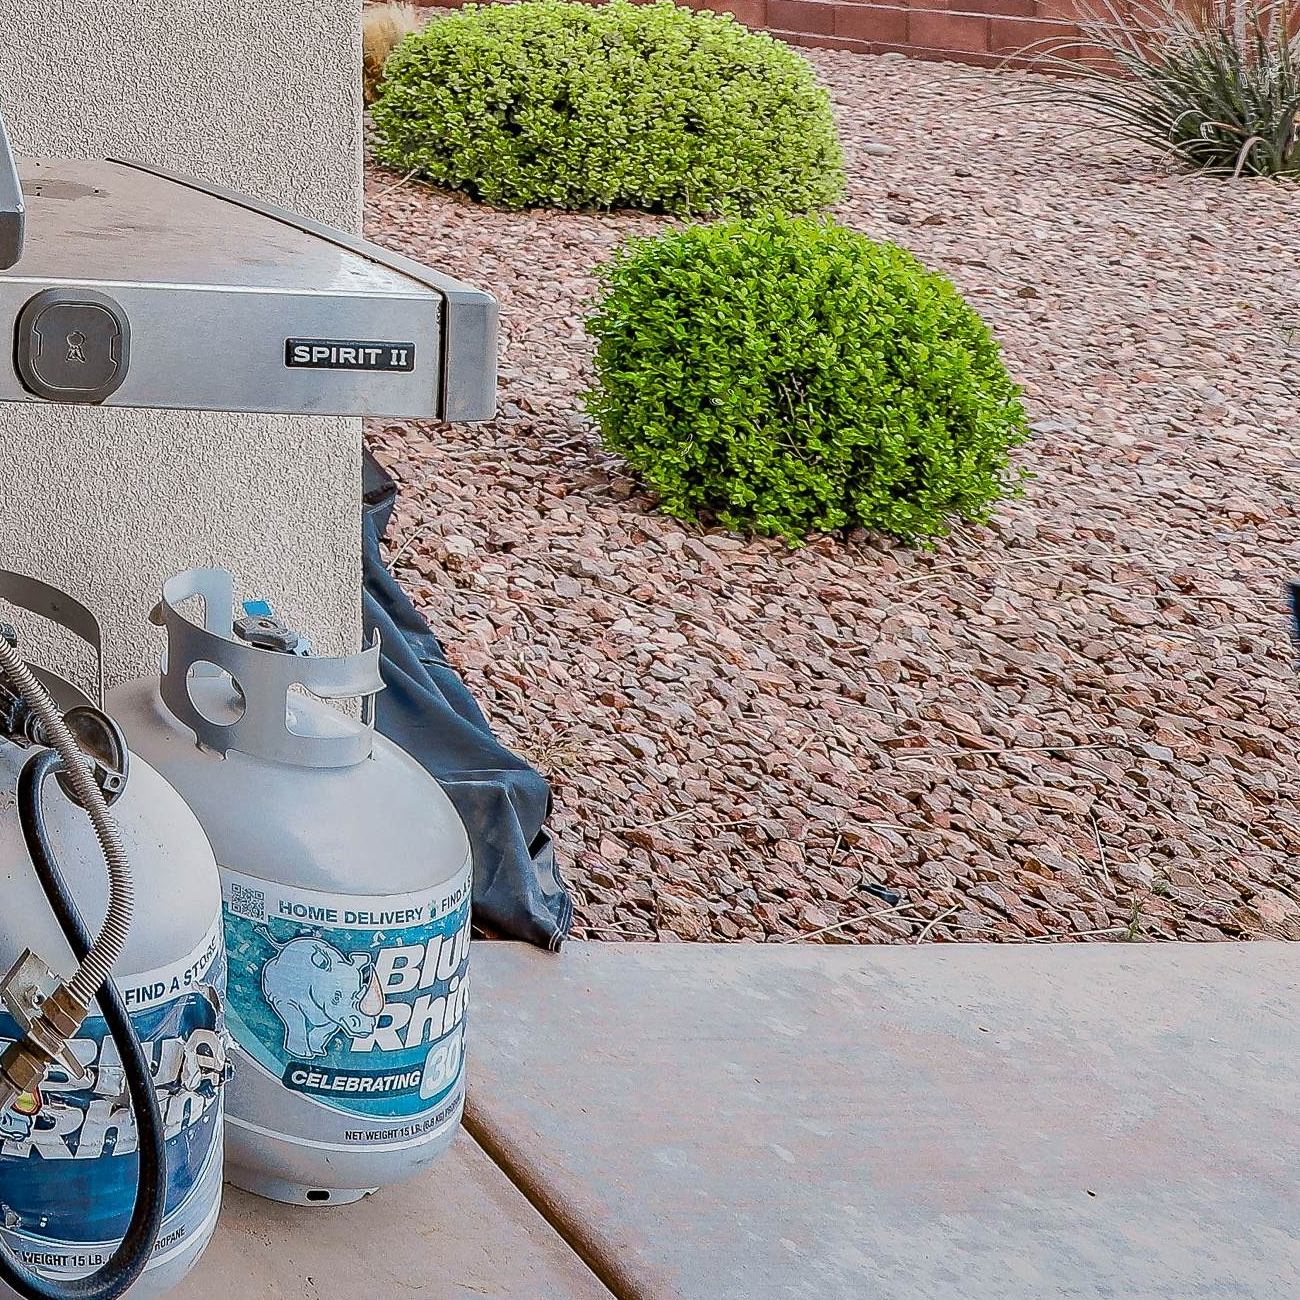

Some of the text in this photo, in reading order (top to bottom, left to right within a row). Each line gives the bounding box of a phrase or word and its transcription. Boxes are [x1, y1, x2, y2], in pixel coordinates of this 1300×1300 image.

[293, 345, 408, 366] SPIRIT II
[278, 899, 338, 923] HOME
[344, 906, 424, 925] DELIVERY
[441, 888, 462, 912] FIND
[124, 982, 166, 1006] FIND
[169, 976, 180, 994] A
[290, 1070, 421, 1093] CELEBRATING
[345, 1130, 363, 1141] NET
[365, 1128, 399, 1141] WEIGHT
[399, 1128, 410, 1138] 15
[154, 1223, 186, 1252] ROPANE
[21, 1251, 68, 1267] WEIGHT
[71, 1255, 85, 1267] 15
[88, 1254, 106, 1266] LB.
